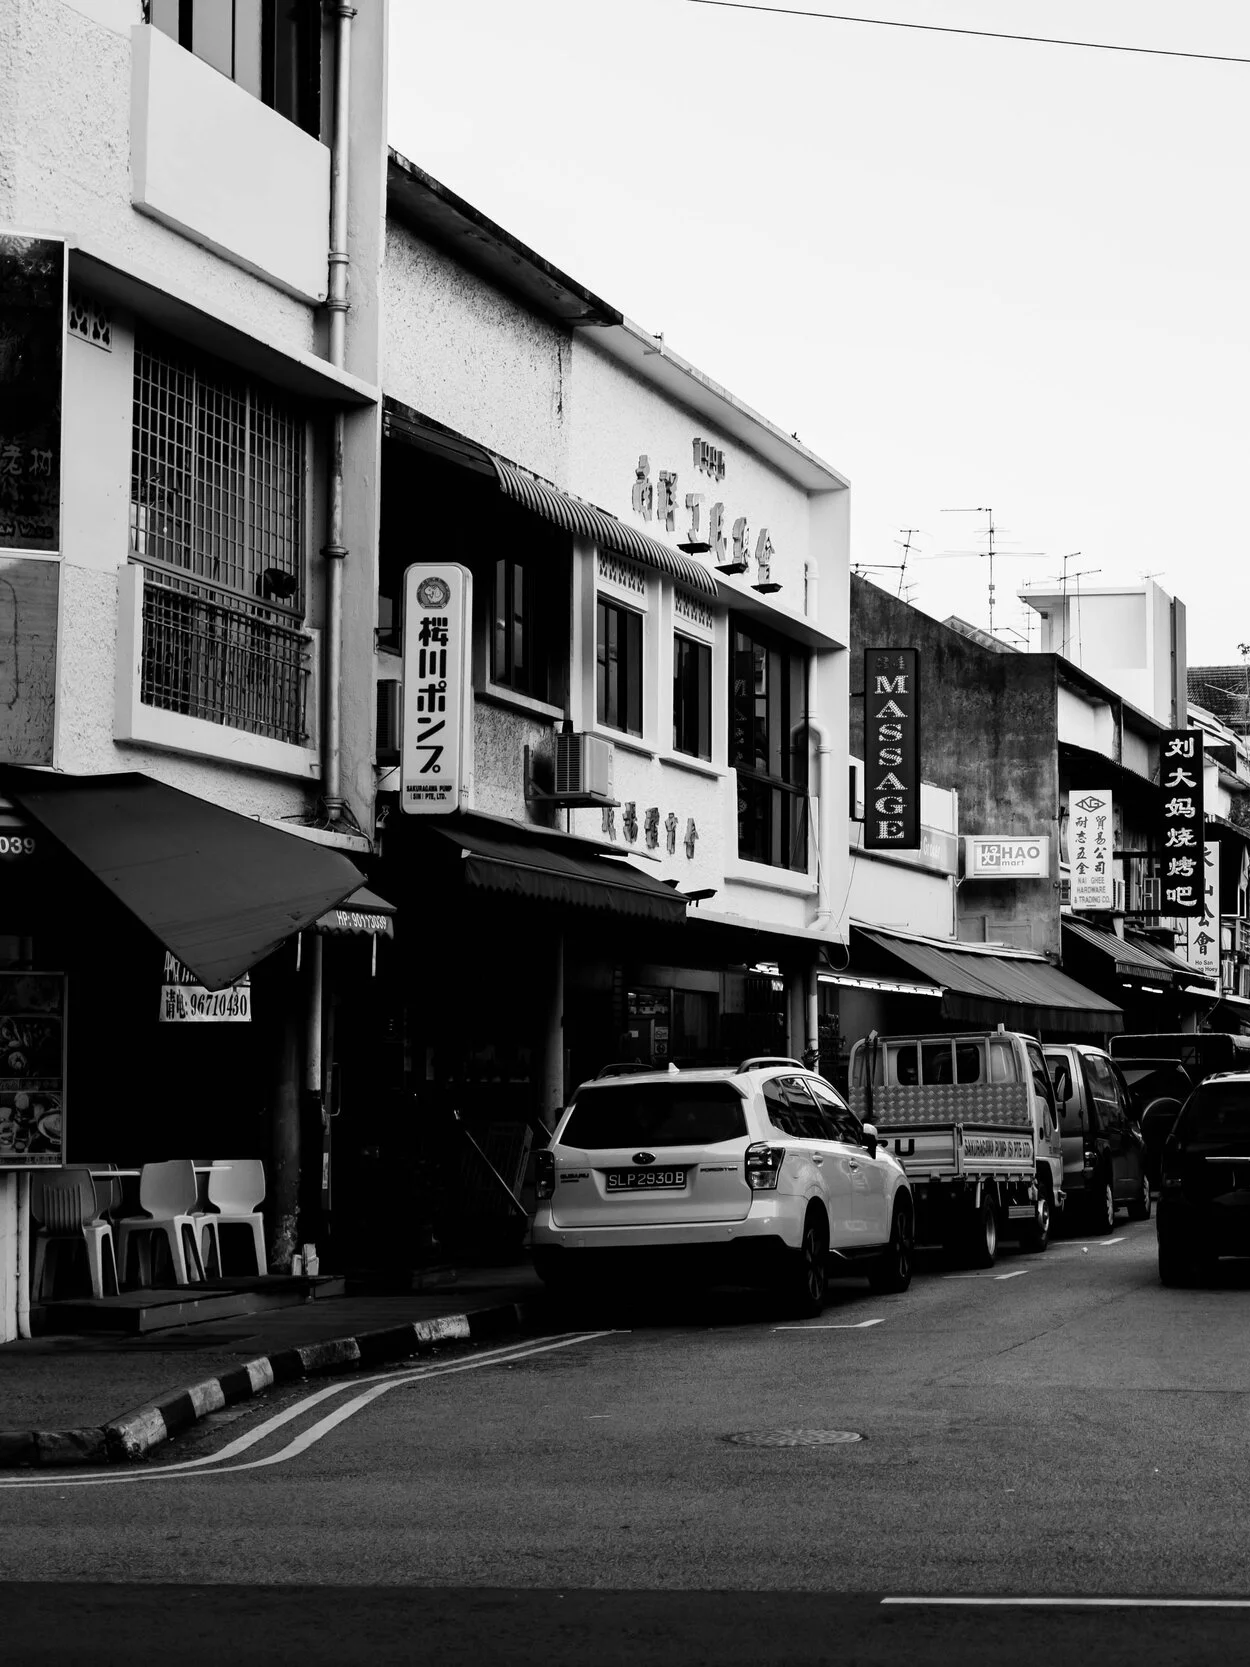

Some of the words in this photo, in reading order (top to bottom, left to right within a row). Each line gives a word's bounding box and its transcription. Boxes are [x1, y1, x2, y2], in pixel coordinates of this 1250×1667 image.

[874, 675, 909, 839] MASSAGE
[1164, 737, 1198, 907] 刘大妈烧烤吧
[1002, 846, 1040, 859] HAO
[1076, 886, 1106, 894] HARDWARE
[190, 993, 247, 1016] 96710430
[608, 1171, 685, 1187] SLP2930B
